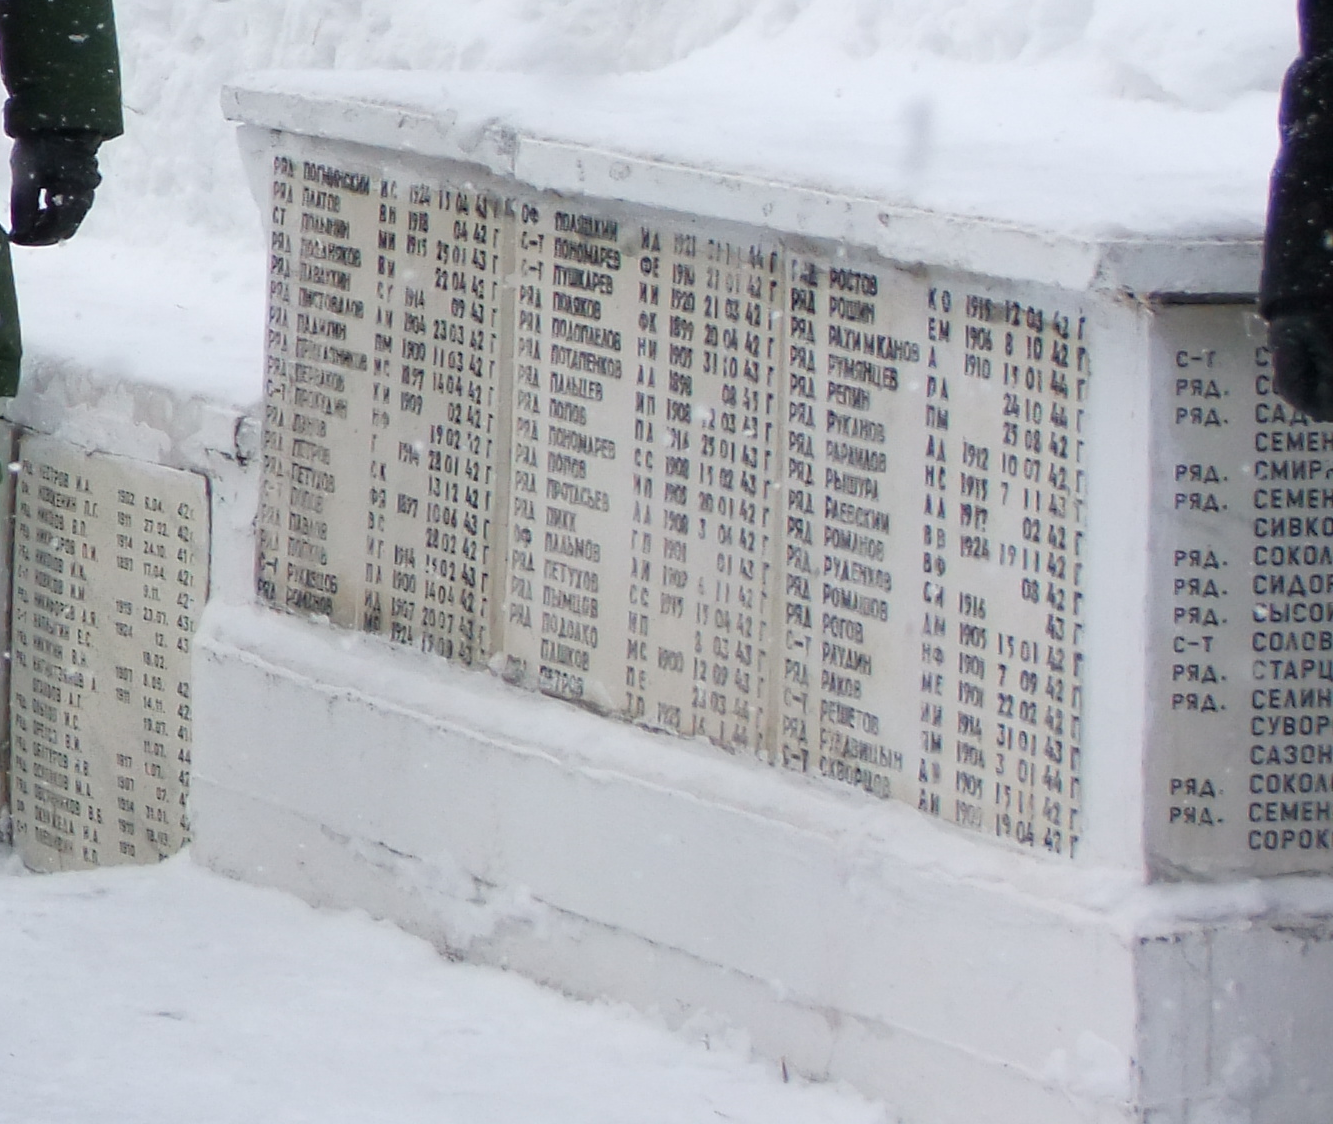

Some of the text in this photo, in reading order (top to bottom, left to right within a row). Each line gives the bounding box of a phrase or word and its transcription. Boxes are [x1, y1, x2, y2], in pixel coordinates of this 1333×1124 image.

[1175, 350, 1216, 369] С-Т
[1254, 431, 1333, 453] СЕМЕН
[1253, 487, 1333, 510] СЕМЕН
[1252, 516, 1333, 539] СИВКО
[1253, 545, 1333, 567] СОКОЛ
[1172, 630, 1333, 654] С-Т СОЛОВ
[1252, 659, 1333, 681] СТАРЦ
[1251, 688, 1333, 710] СЕЛИН
[1250, 715, 1333, 737] СУВОР
[1249, 744, 1333, 766] САЗОН
[1249, 772, 1333, 795] СОКОЛ
[1248, 800, 1333, 823] СЕМЕН
[1248, 828, 1333, 851] СОРОК
